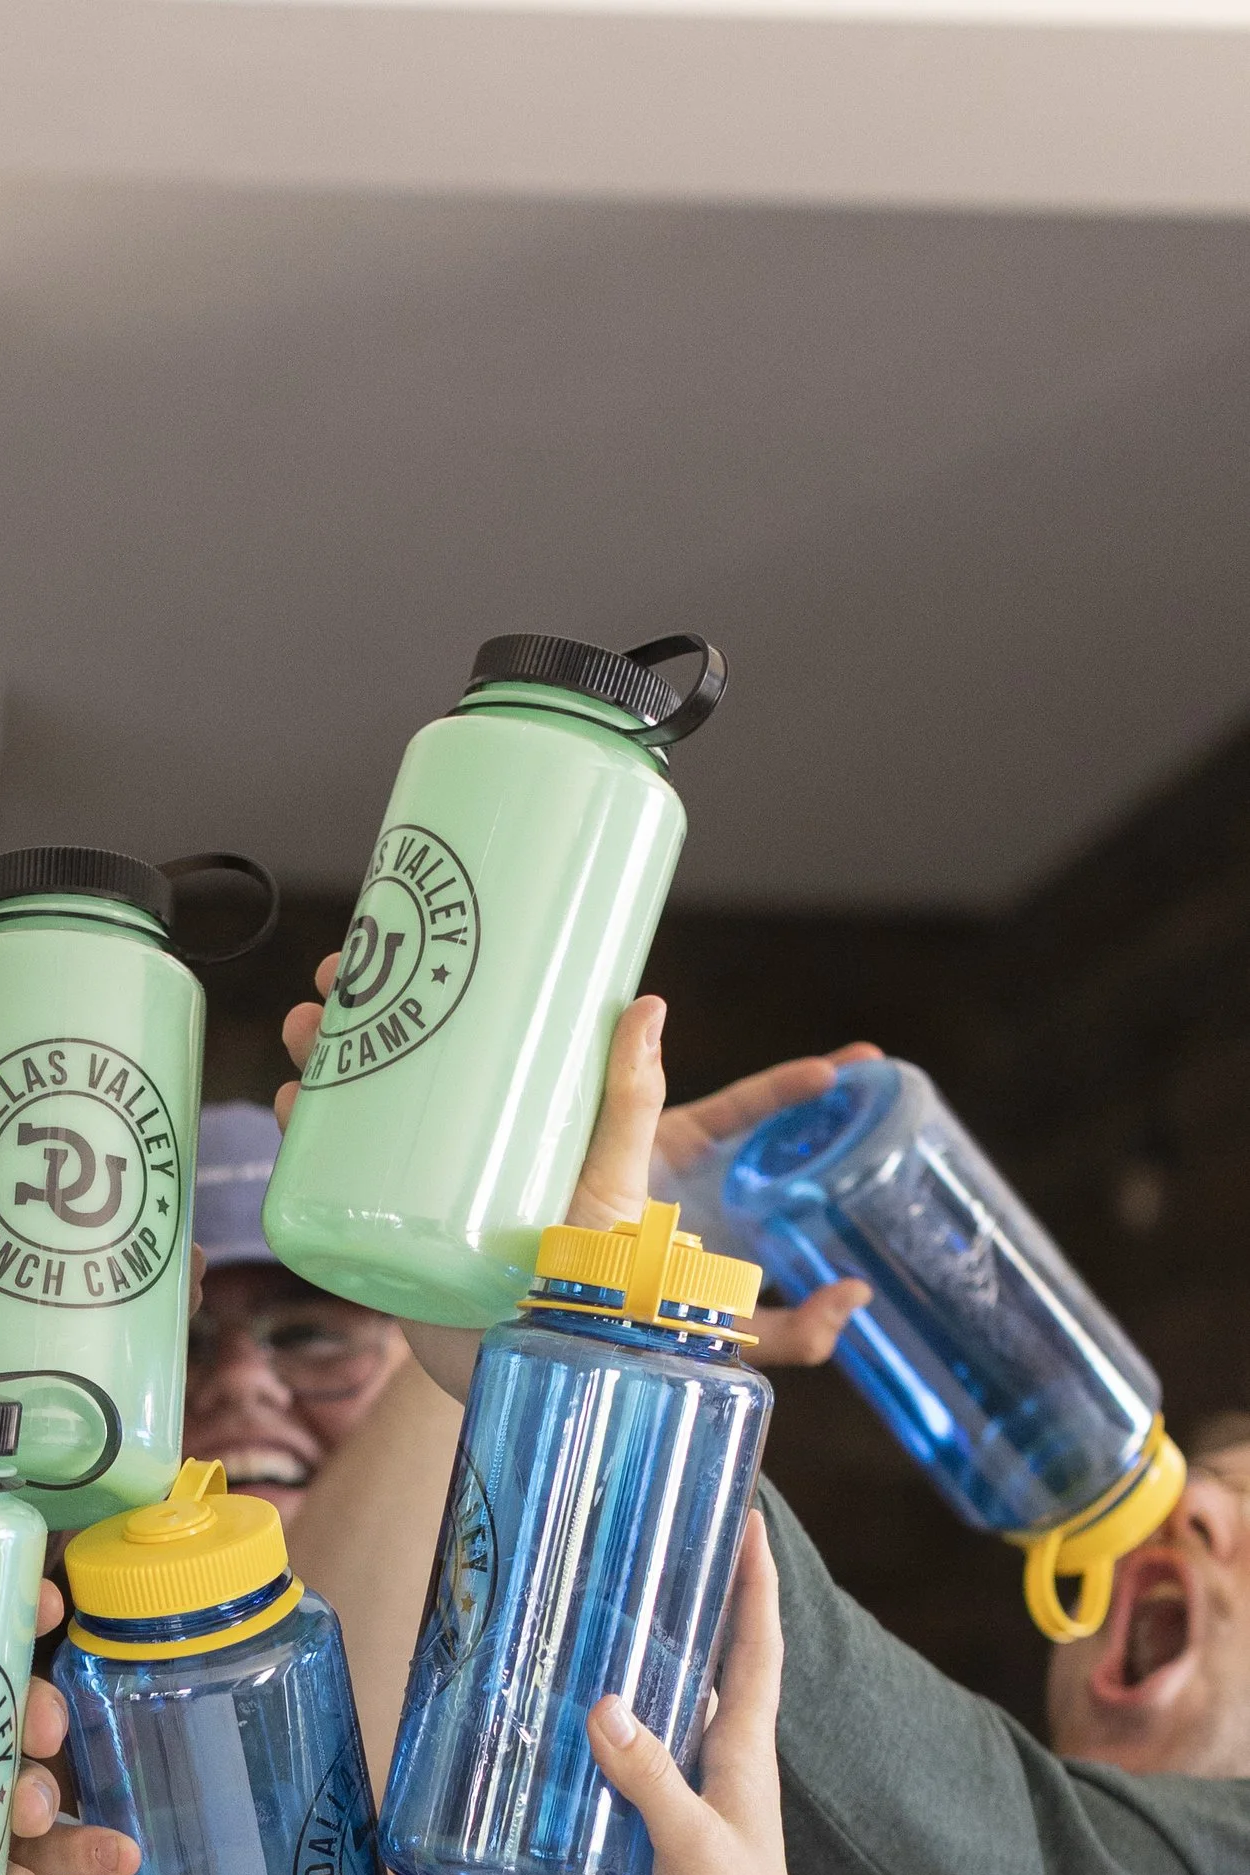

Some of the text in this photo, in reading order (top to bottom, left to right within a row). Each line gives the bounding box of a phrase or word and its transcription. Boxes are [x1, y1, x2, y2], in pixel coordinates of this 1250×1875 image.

[393, 836, 467, 946] VALLEY
[337, 998, 425, 1074] CAMP
[88, 1053, 175, 1178] VALLEY
[83, 1226, 162, 1297] CAMP
